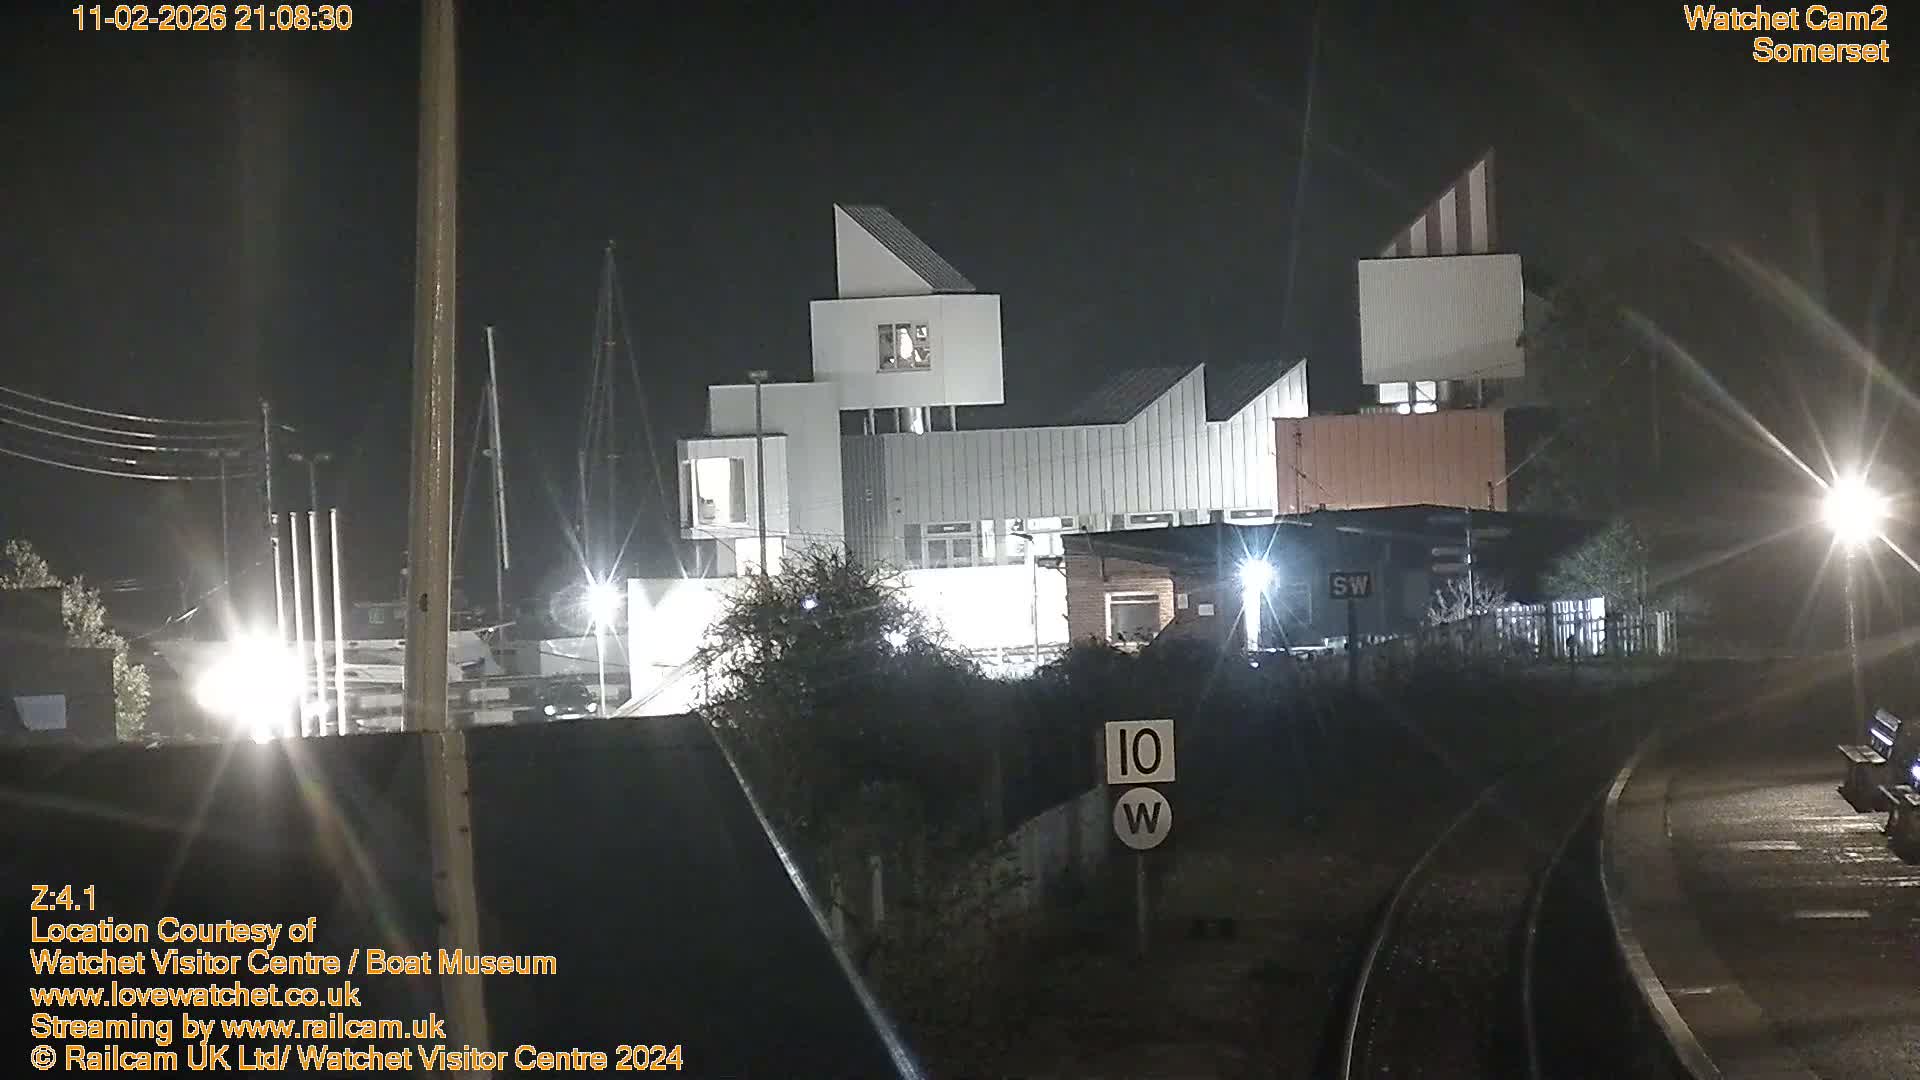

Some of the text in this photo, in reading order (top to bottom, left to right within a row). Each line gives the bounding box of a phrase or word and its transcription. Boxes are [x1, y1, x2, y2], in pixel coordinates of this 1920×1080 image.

[1332, 575, 1368, 595] SW
[1119, 728, 1162, 776] 10
[1123, 802, 1161, 834] W
